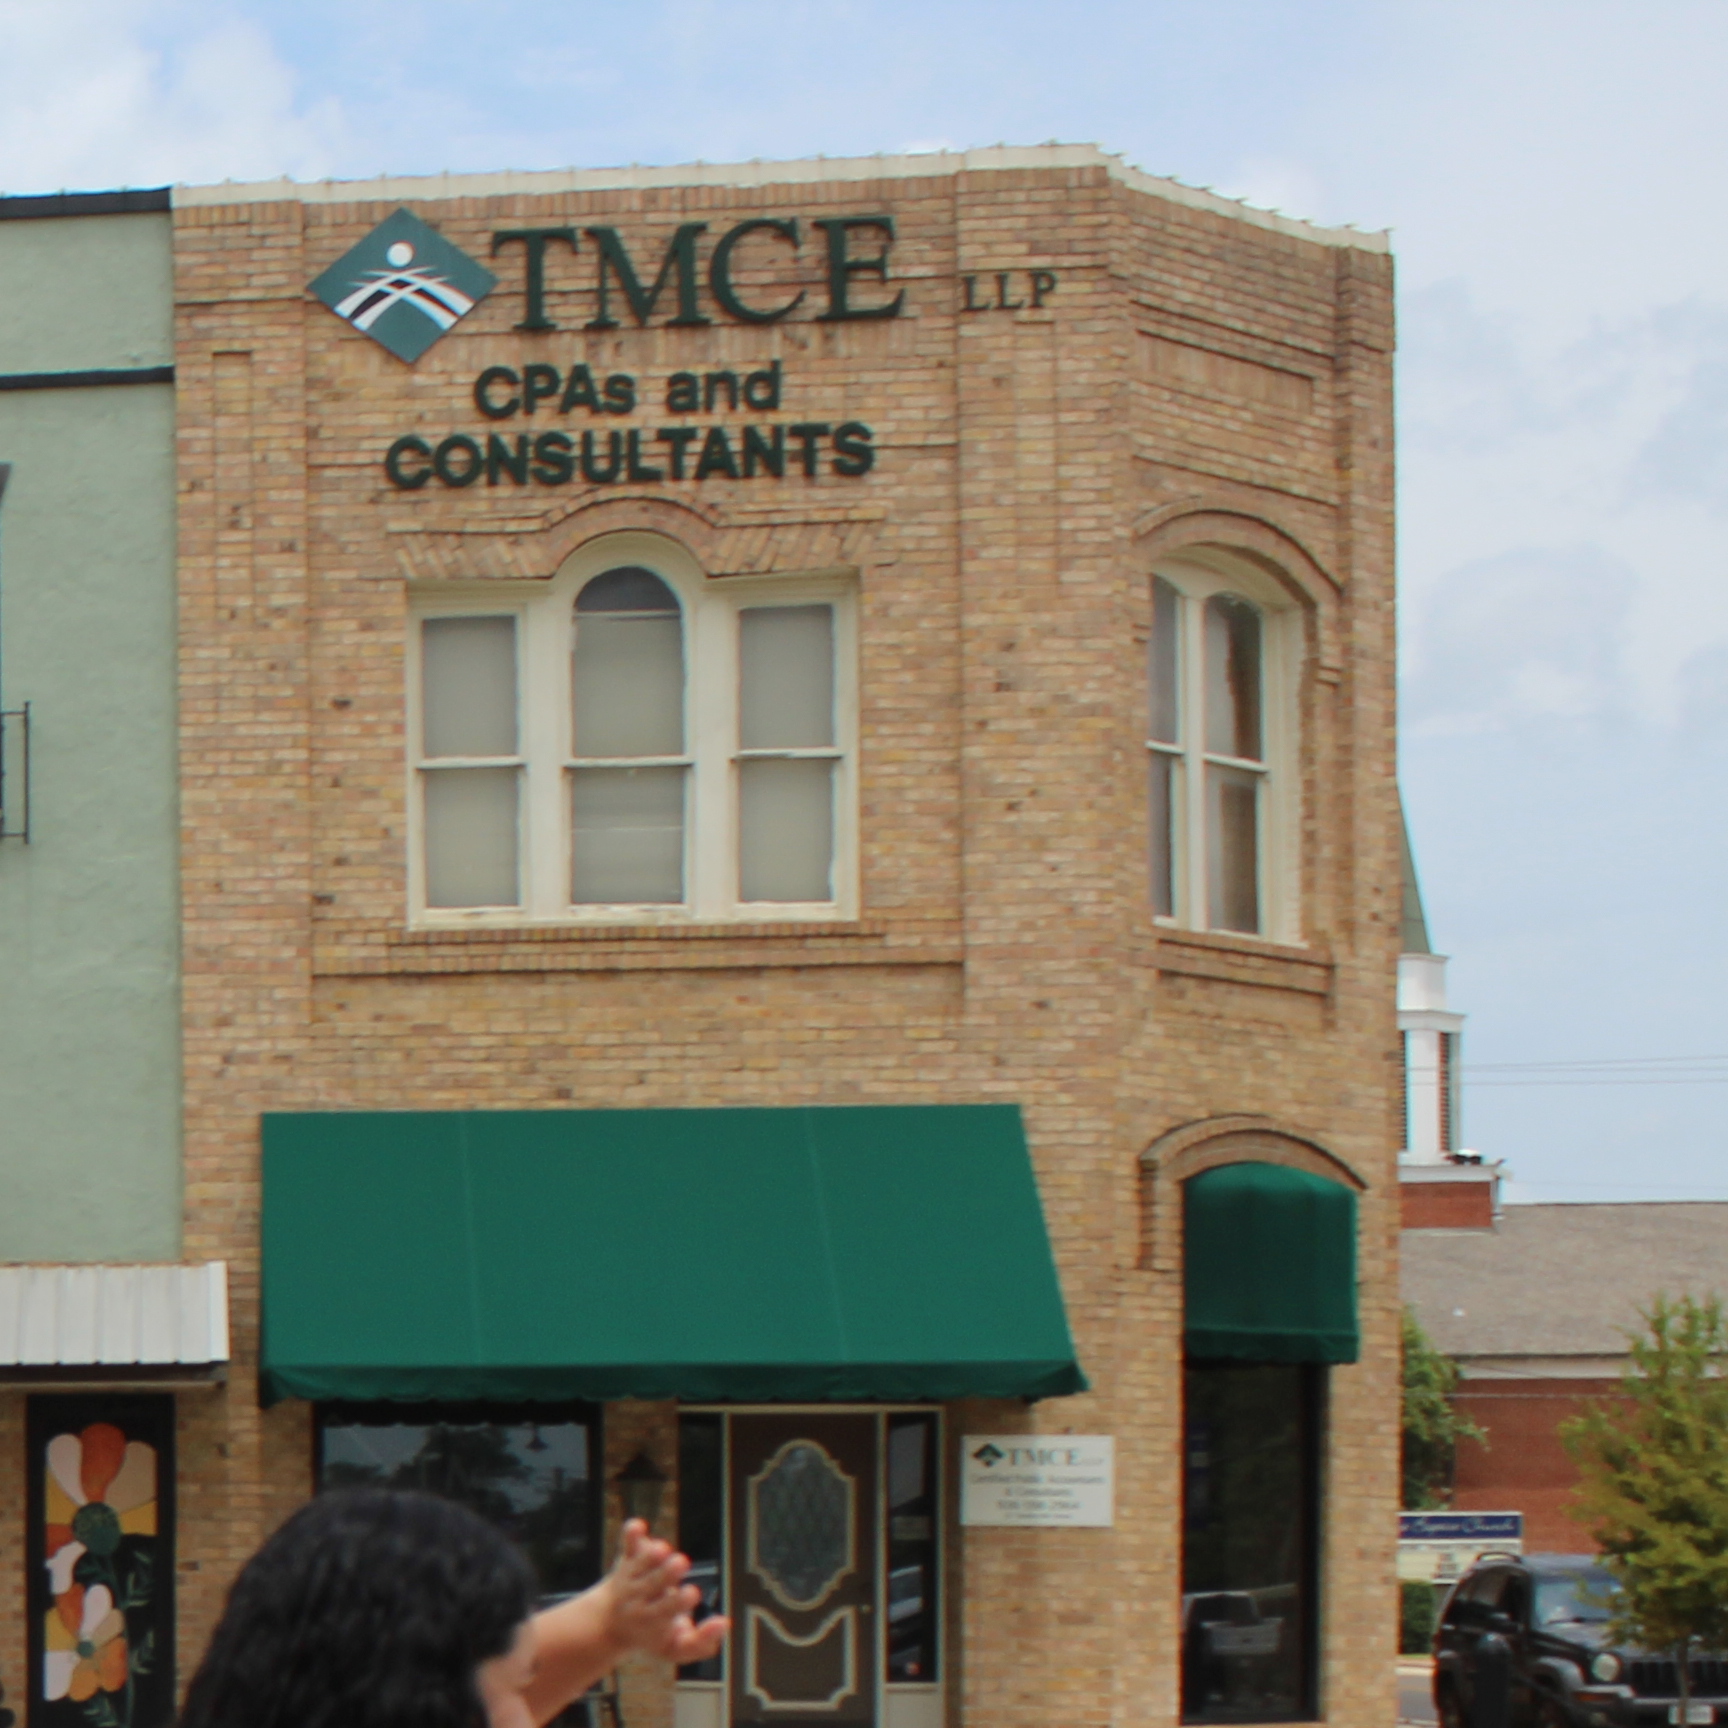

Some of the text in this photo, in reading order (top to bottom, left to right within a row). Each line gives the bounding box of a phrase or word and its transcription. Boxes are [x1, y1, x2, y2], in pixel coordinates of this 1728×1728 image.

[490, 215, 1059, 332] TMCE LLP
[473, 359, 782, 419] CPAs and
[384, 421, 876, 490] CONSULTANTS
